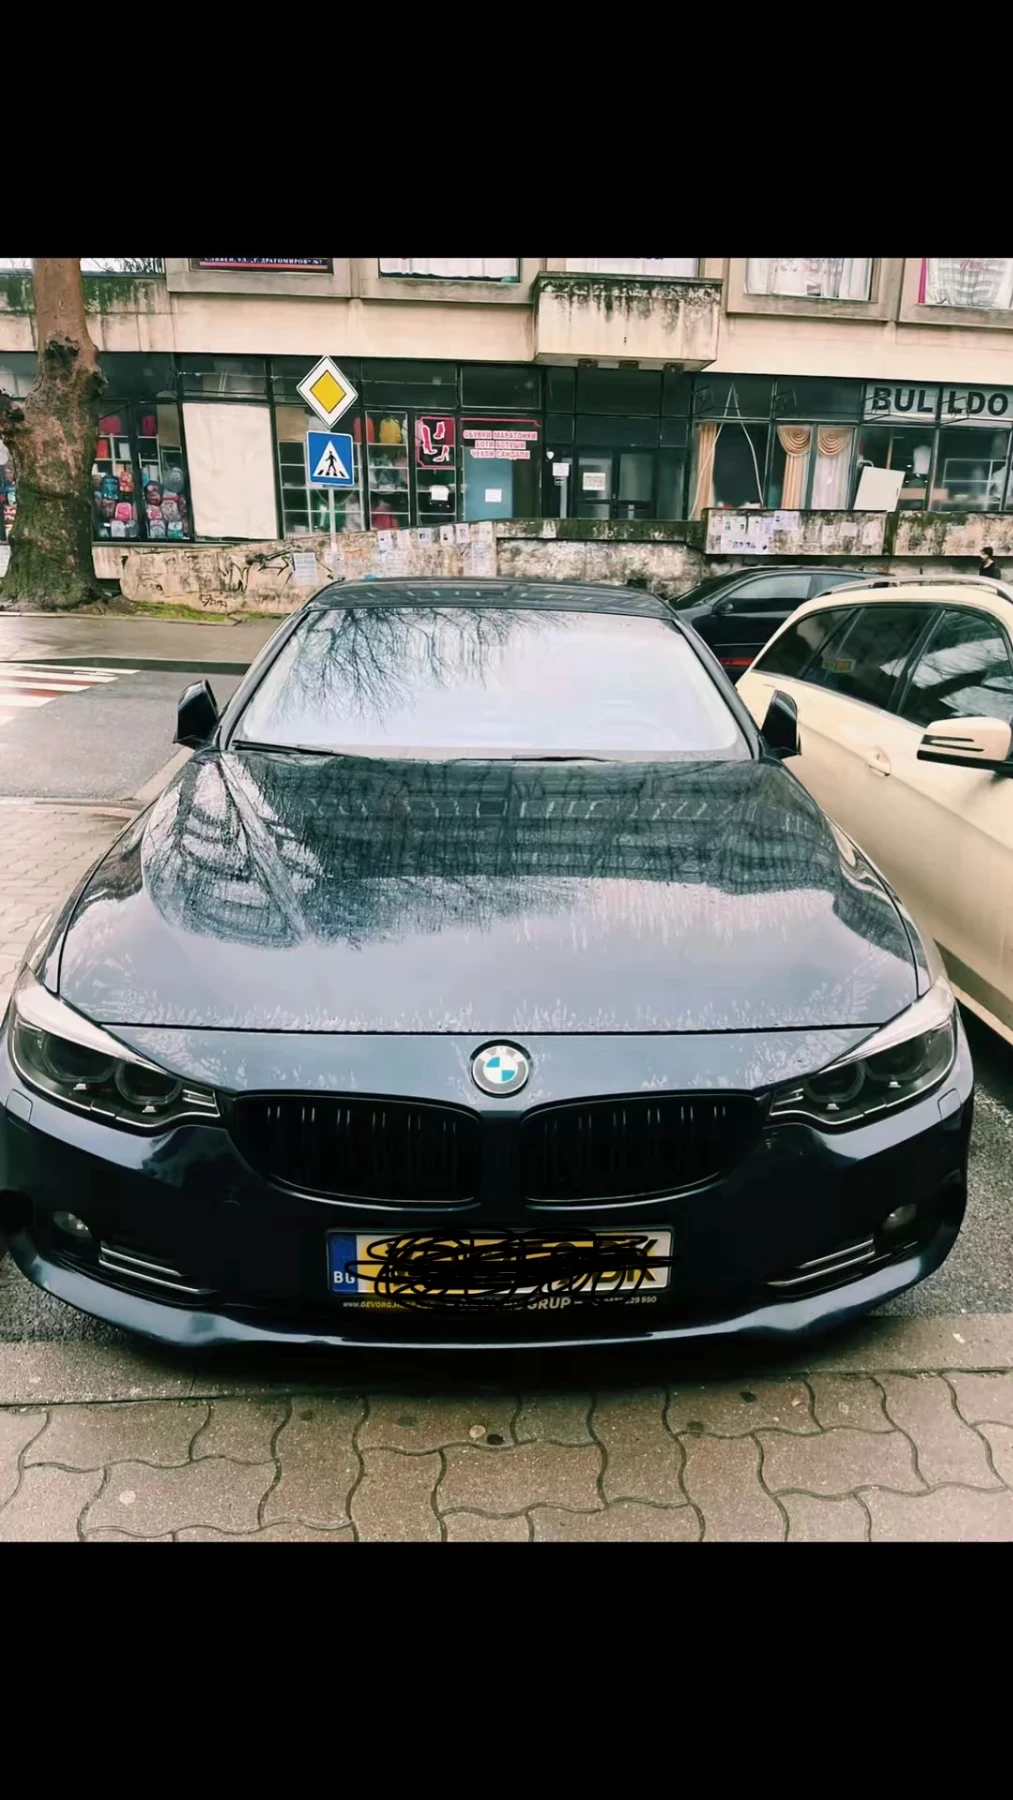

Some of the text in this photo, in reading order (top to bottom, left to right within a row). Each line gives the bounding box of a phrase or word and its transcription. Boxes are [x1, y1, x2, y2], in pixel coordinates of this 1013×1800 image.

[871, 386, 1009, 416] BULLDO
[464, 430, 537, 440] ОБУВКИ МАРАТОНКИ
[333, 1270, 356, 1285] BG
